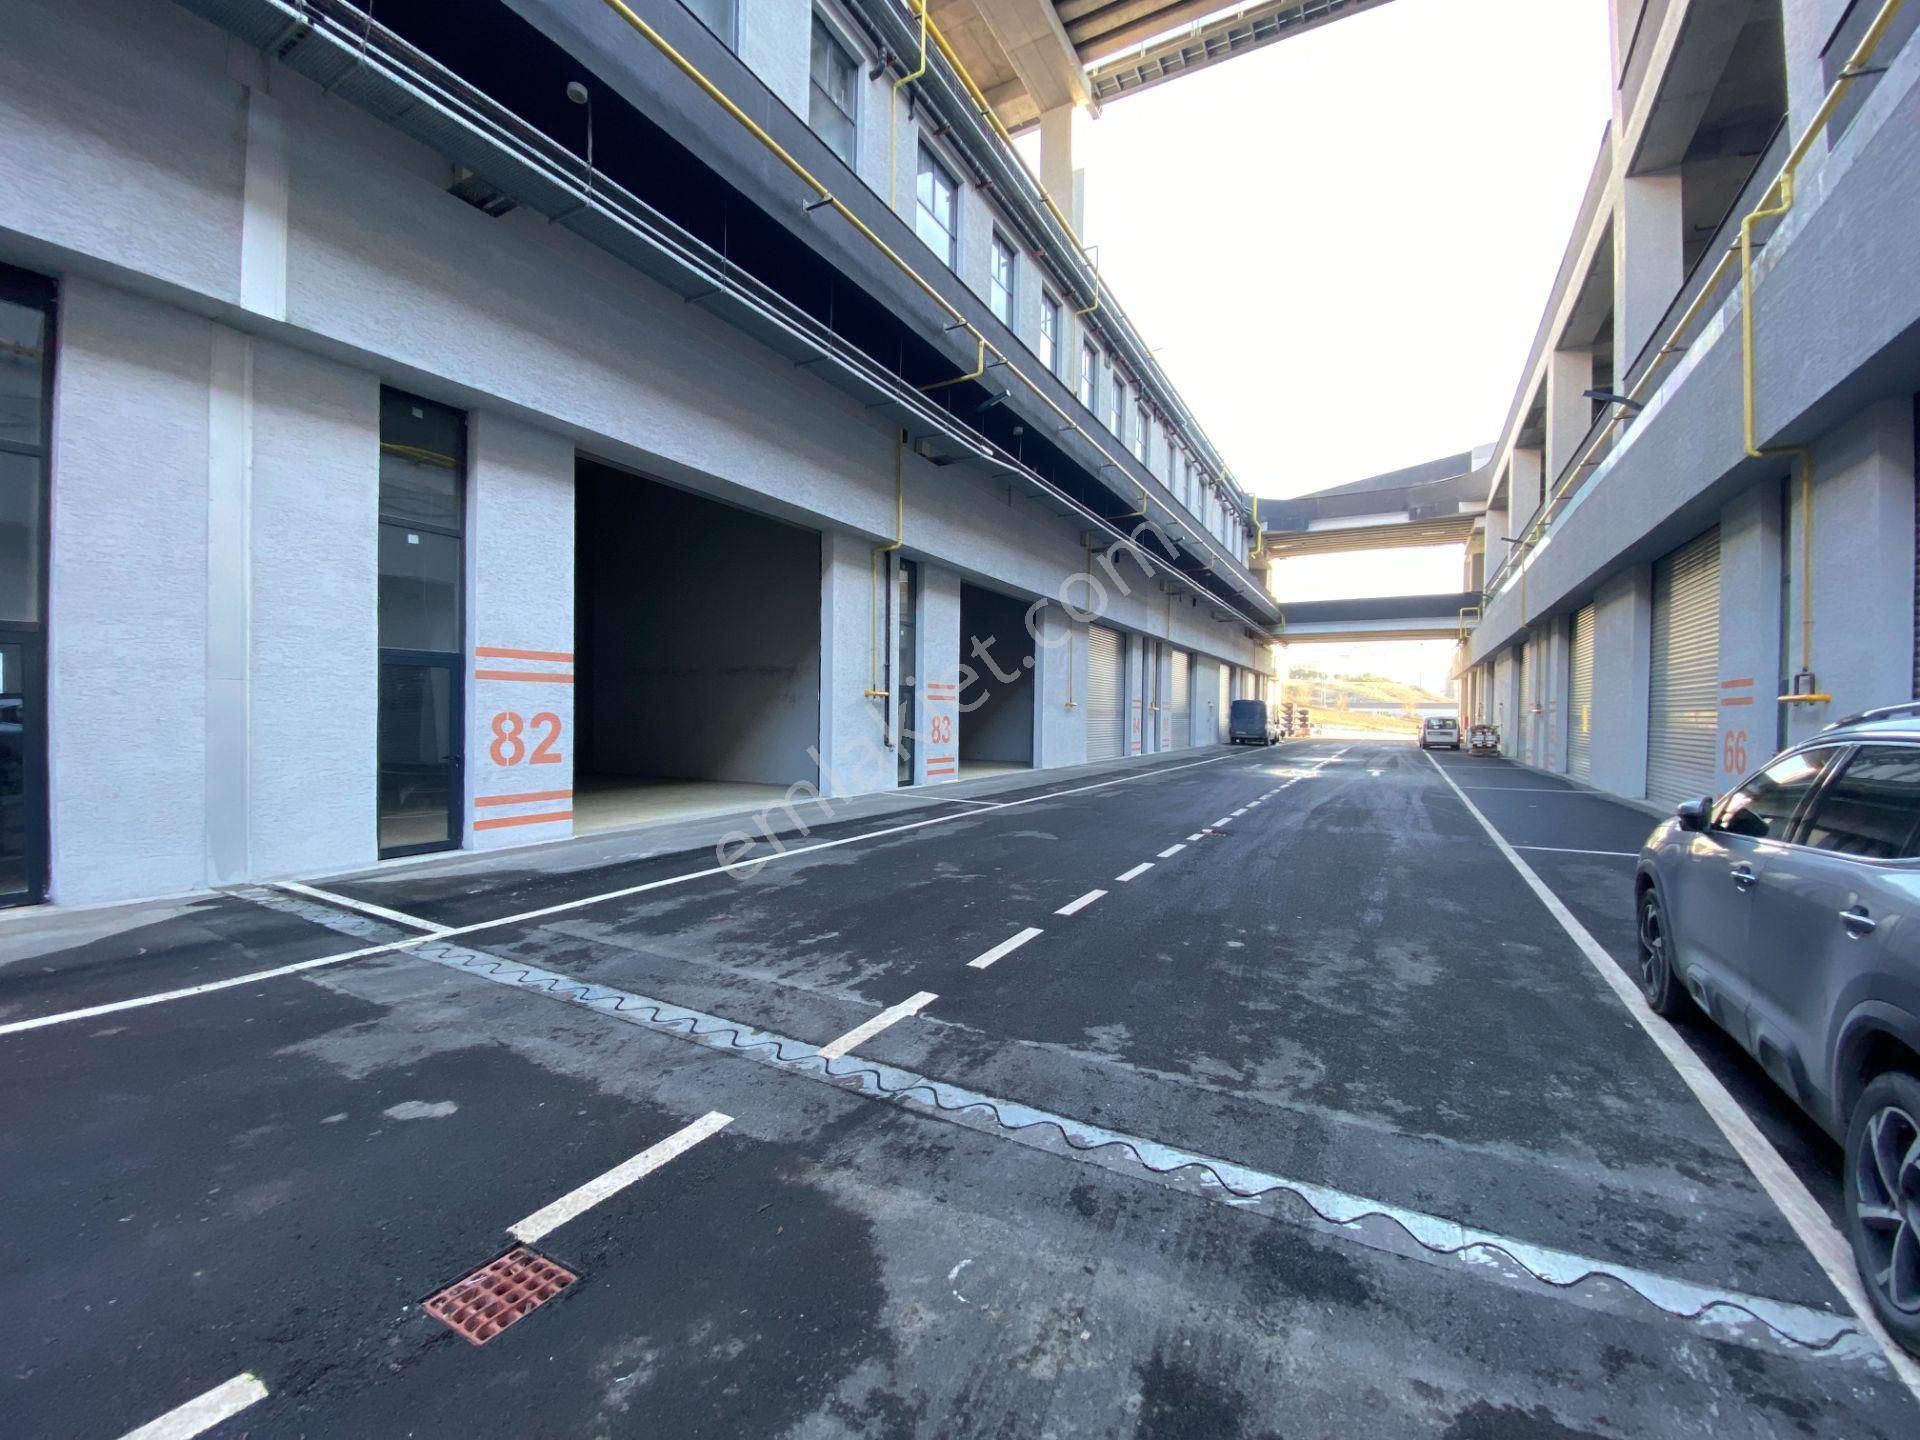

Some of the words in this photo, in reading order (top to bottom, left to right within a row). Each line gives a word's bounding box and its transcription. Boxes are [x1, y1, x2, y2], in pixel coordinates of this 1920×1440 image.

[490, 711, 562, 767] 82
[931, 715, 951, 744] 83
[1723, 729, 1748, 775] 66
